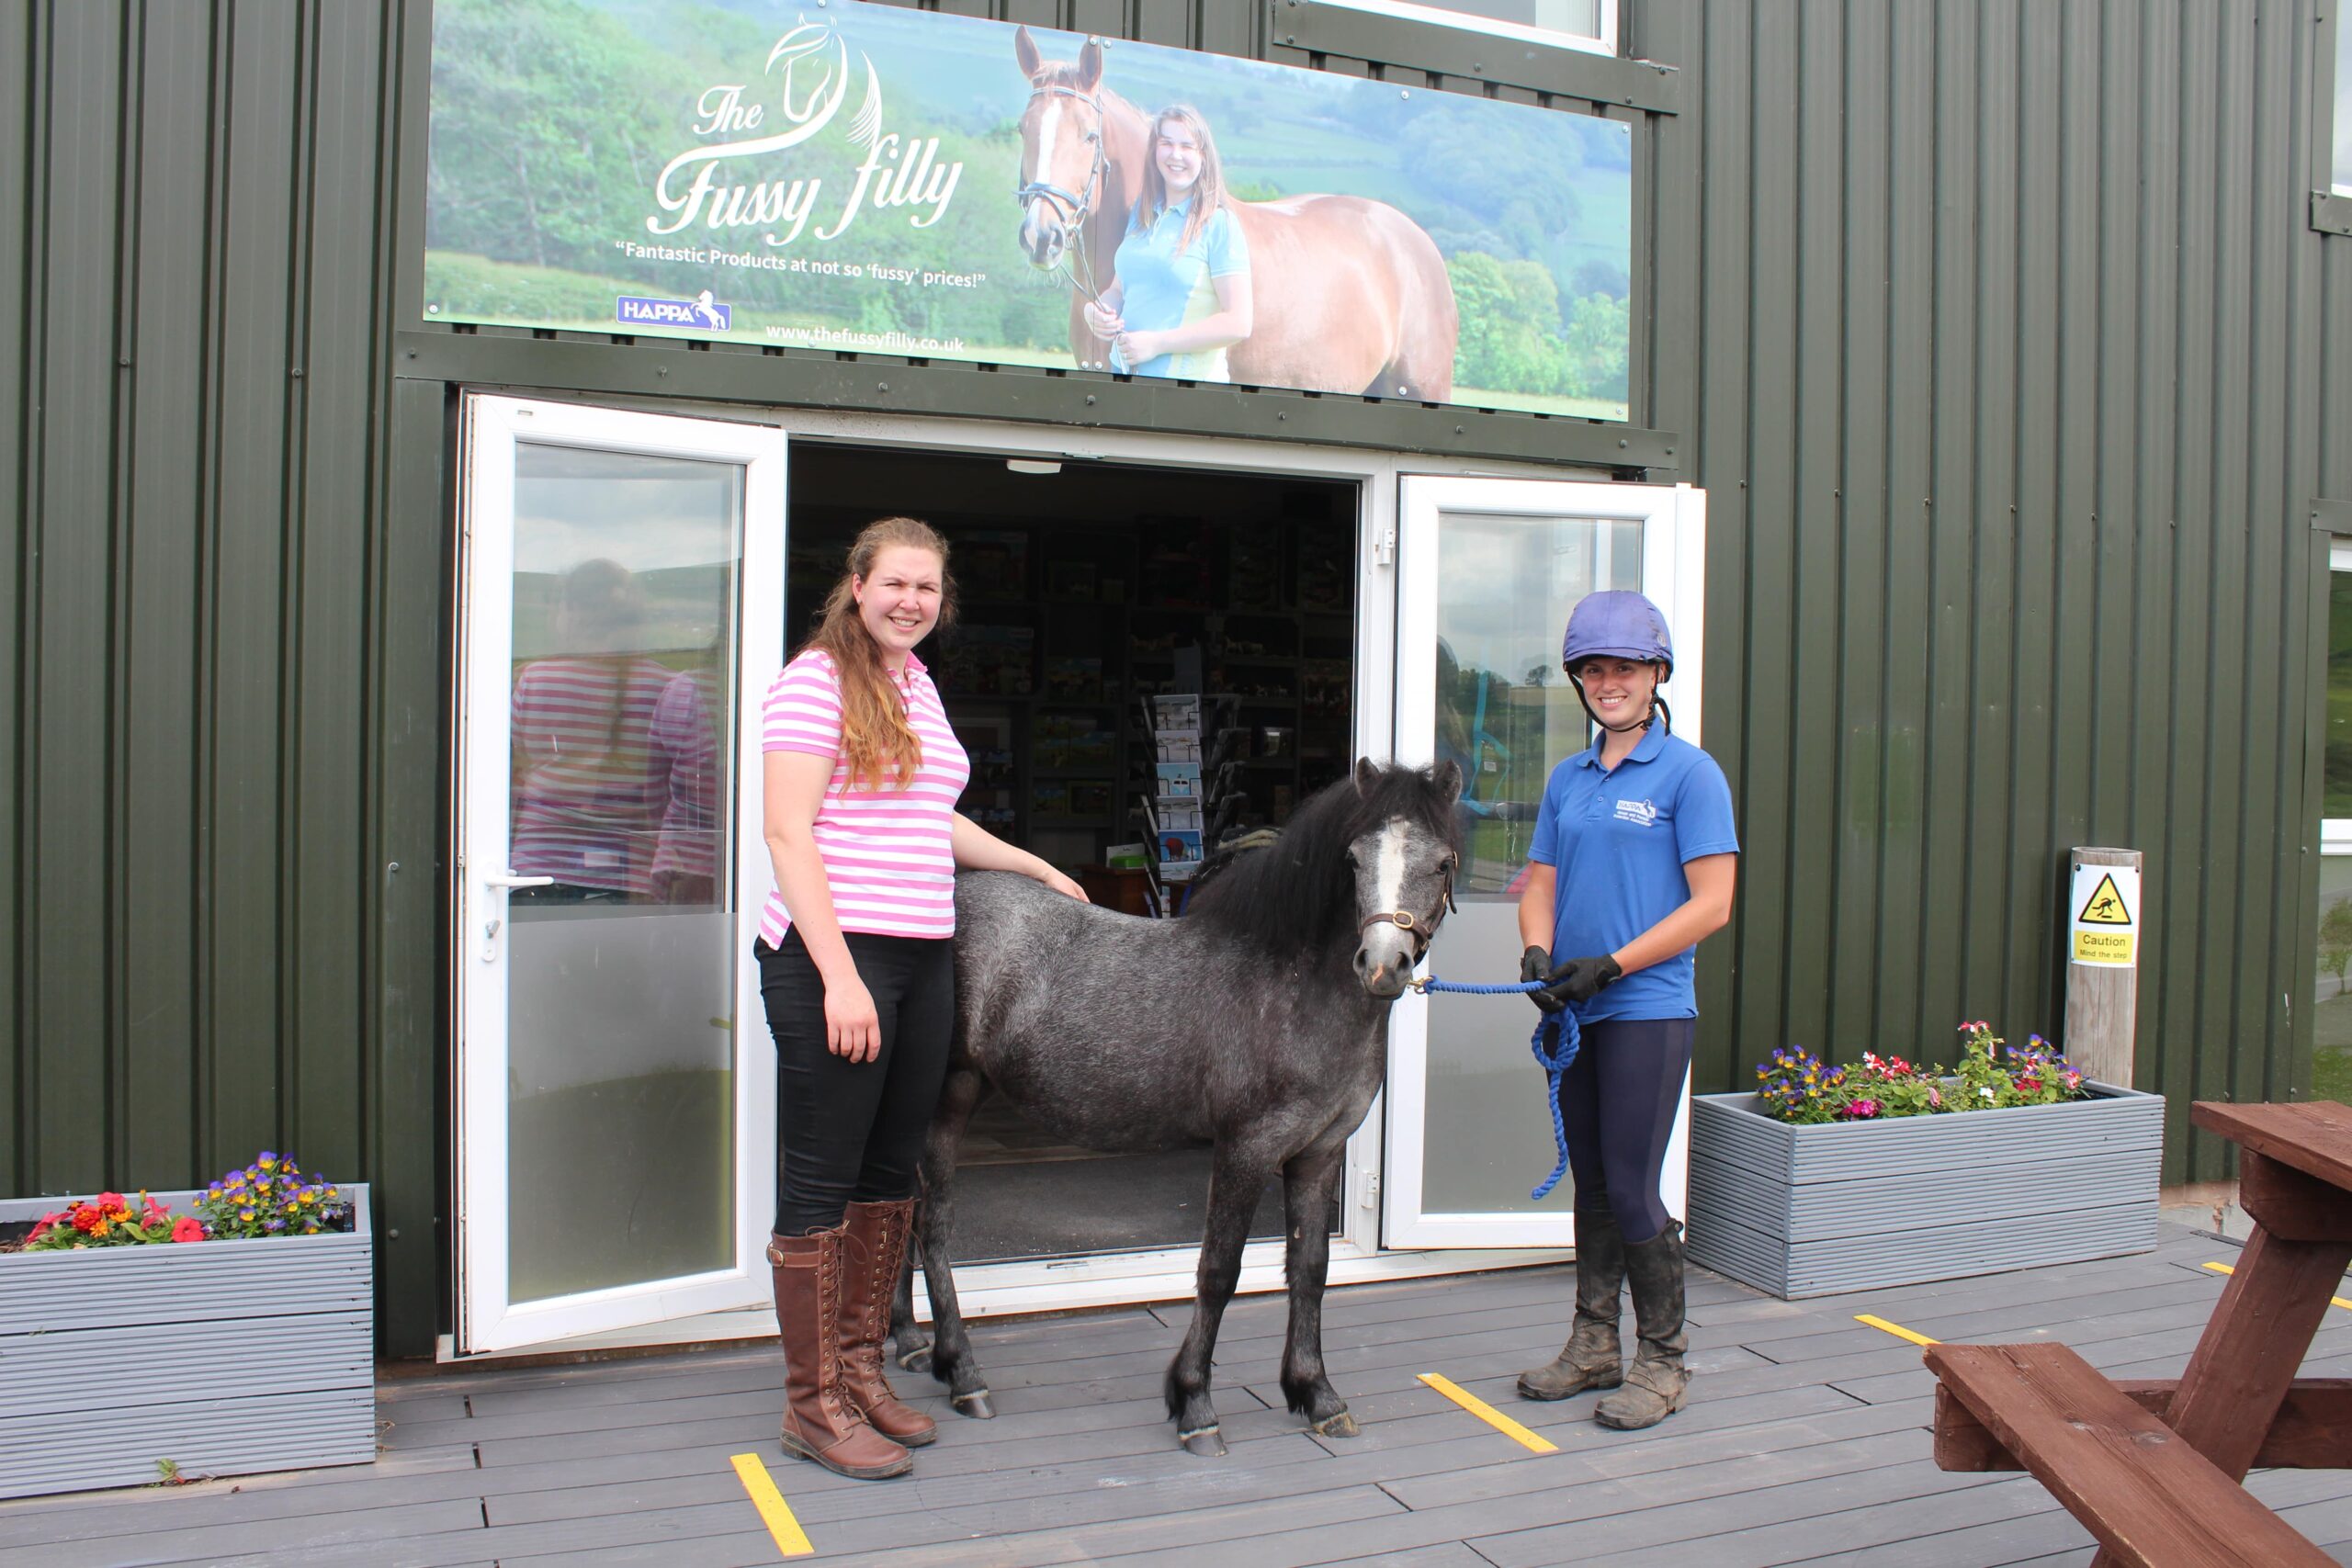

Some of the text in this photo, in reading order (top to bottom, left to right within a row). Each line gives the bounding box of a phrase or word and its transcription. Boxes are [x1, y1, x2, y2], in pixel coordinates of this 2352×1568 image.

[692, 85, 763, 135] The
[647, 133, 964, 246] Fussy filly
[616, 241, 987, 288] “Fantastic Products at not so ‘fussy’ prices!”
[624, 301, 695, 323] HAPPA
[766, 325, 964, 353] www.thefussyfilly.co.uk
[2080, 949, 2097, 957] Mind
[2098, 950, 2110, 958] the
[2083, 934, 2126, 946] Caution
